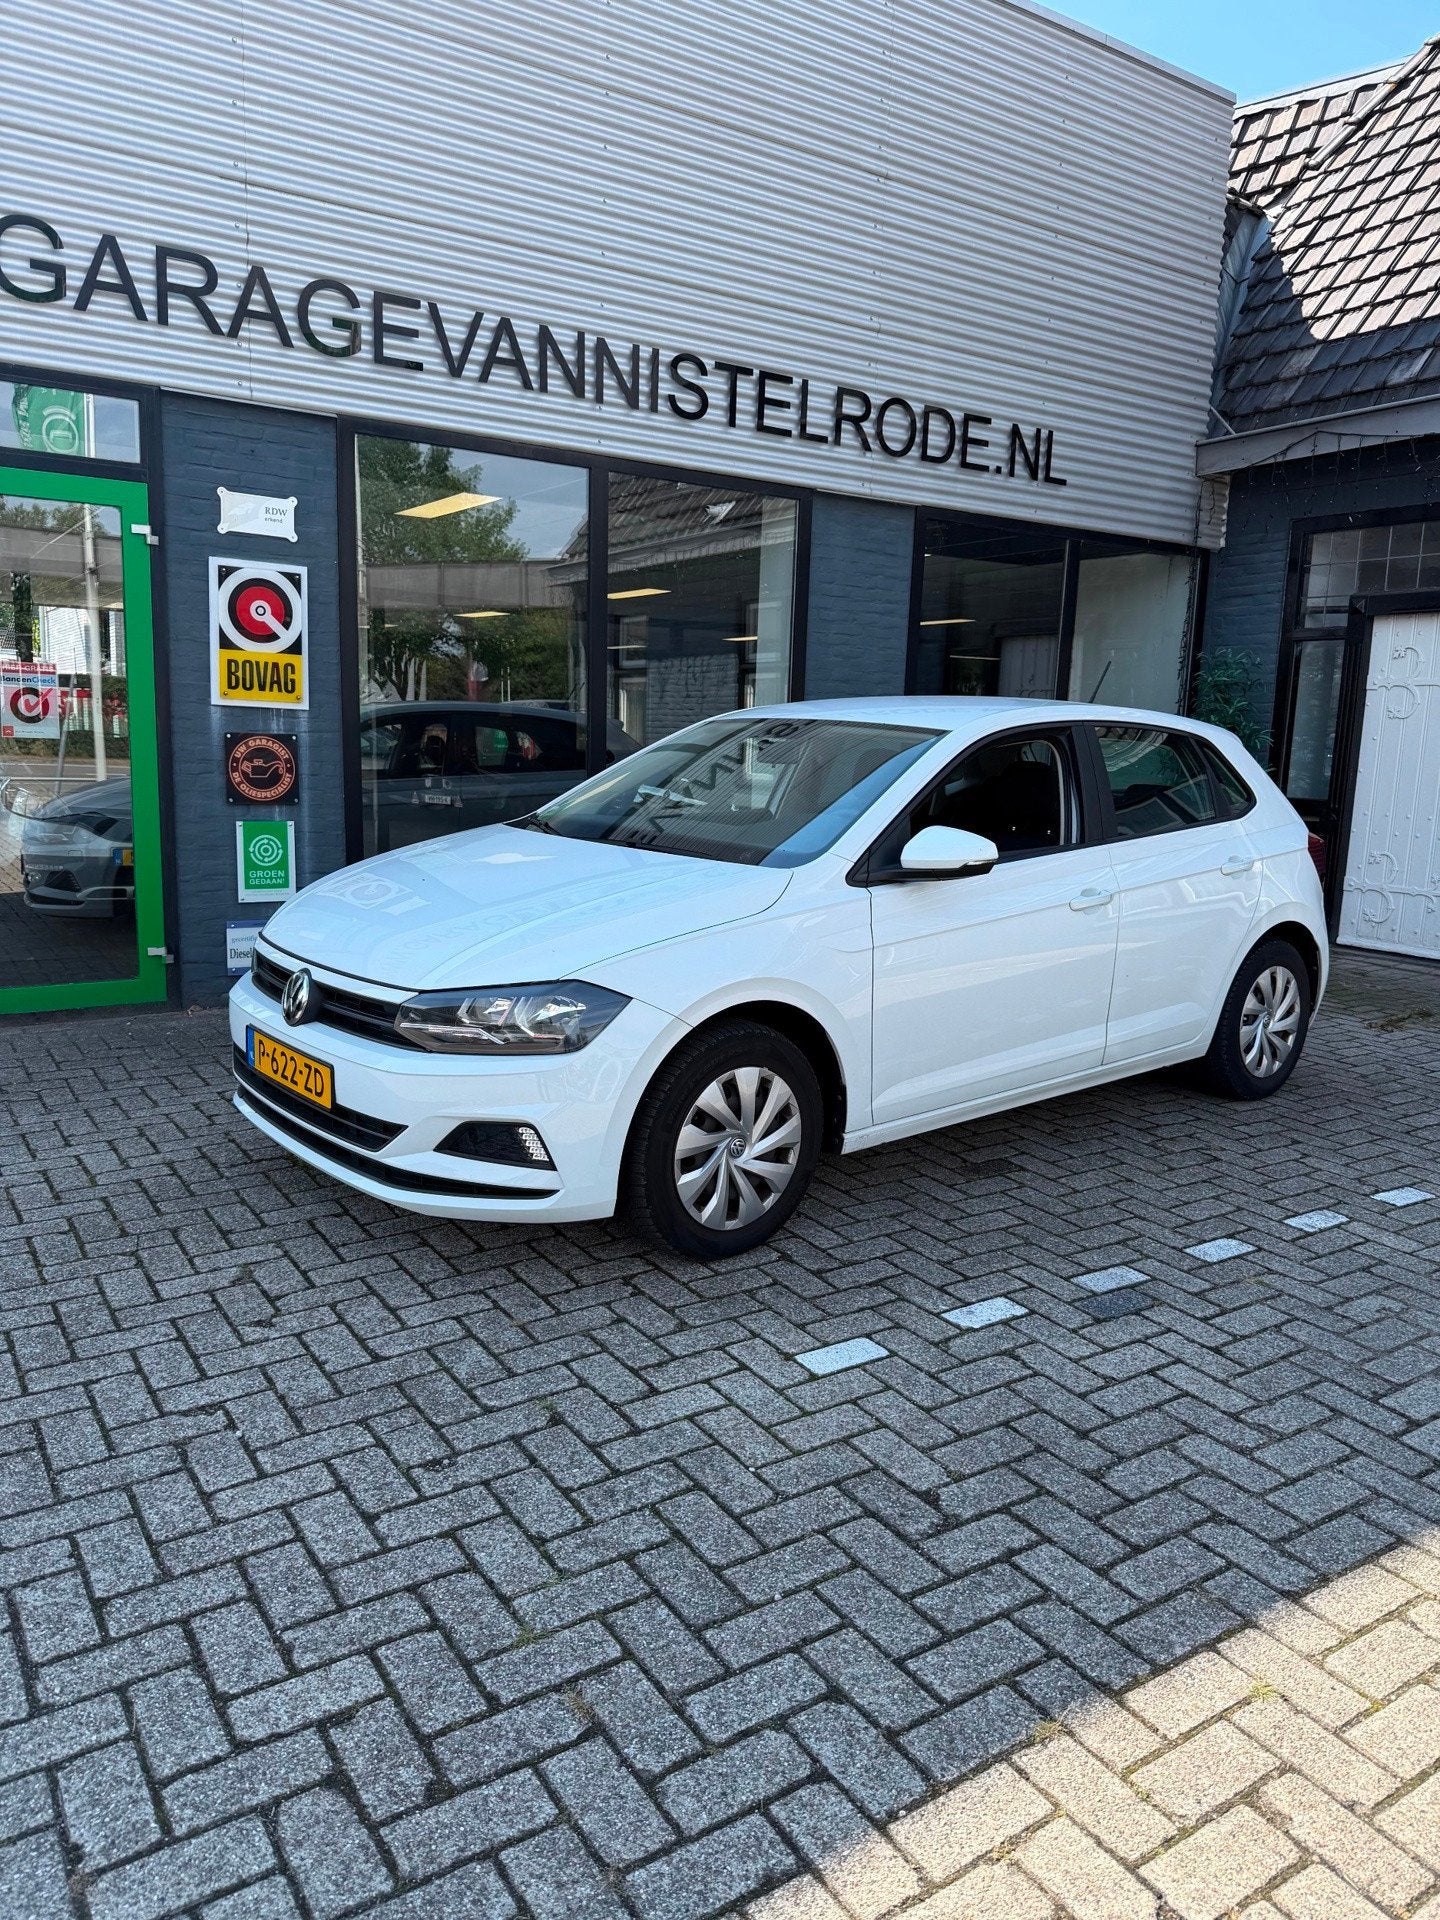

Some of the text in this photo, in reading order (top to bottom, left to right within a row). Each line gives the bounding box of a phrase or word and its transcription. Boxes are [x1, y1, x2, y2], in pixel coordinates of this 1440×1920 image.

[0, 214, 1067, 486] GARAGEVANNISTELRODE.NL
[265, 506, 288, 517] RDW
[227, 658, 296, 694] BOVAG
[234, 738, 290, 759] UW GARAGIST
[232, 772, 293, 798] DE OLIESPECIALIST
[249, 870, 285, 878] GROEN
[258, 1038, 325, 1098] P-622-ZD
